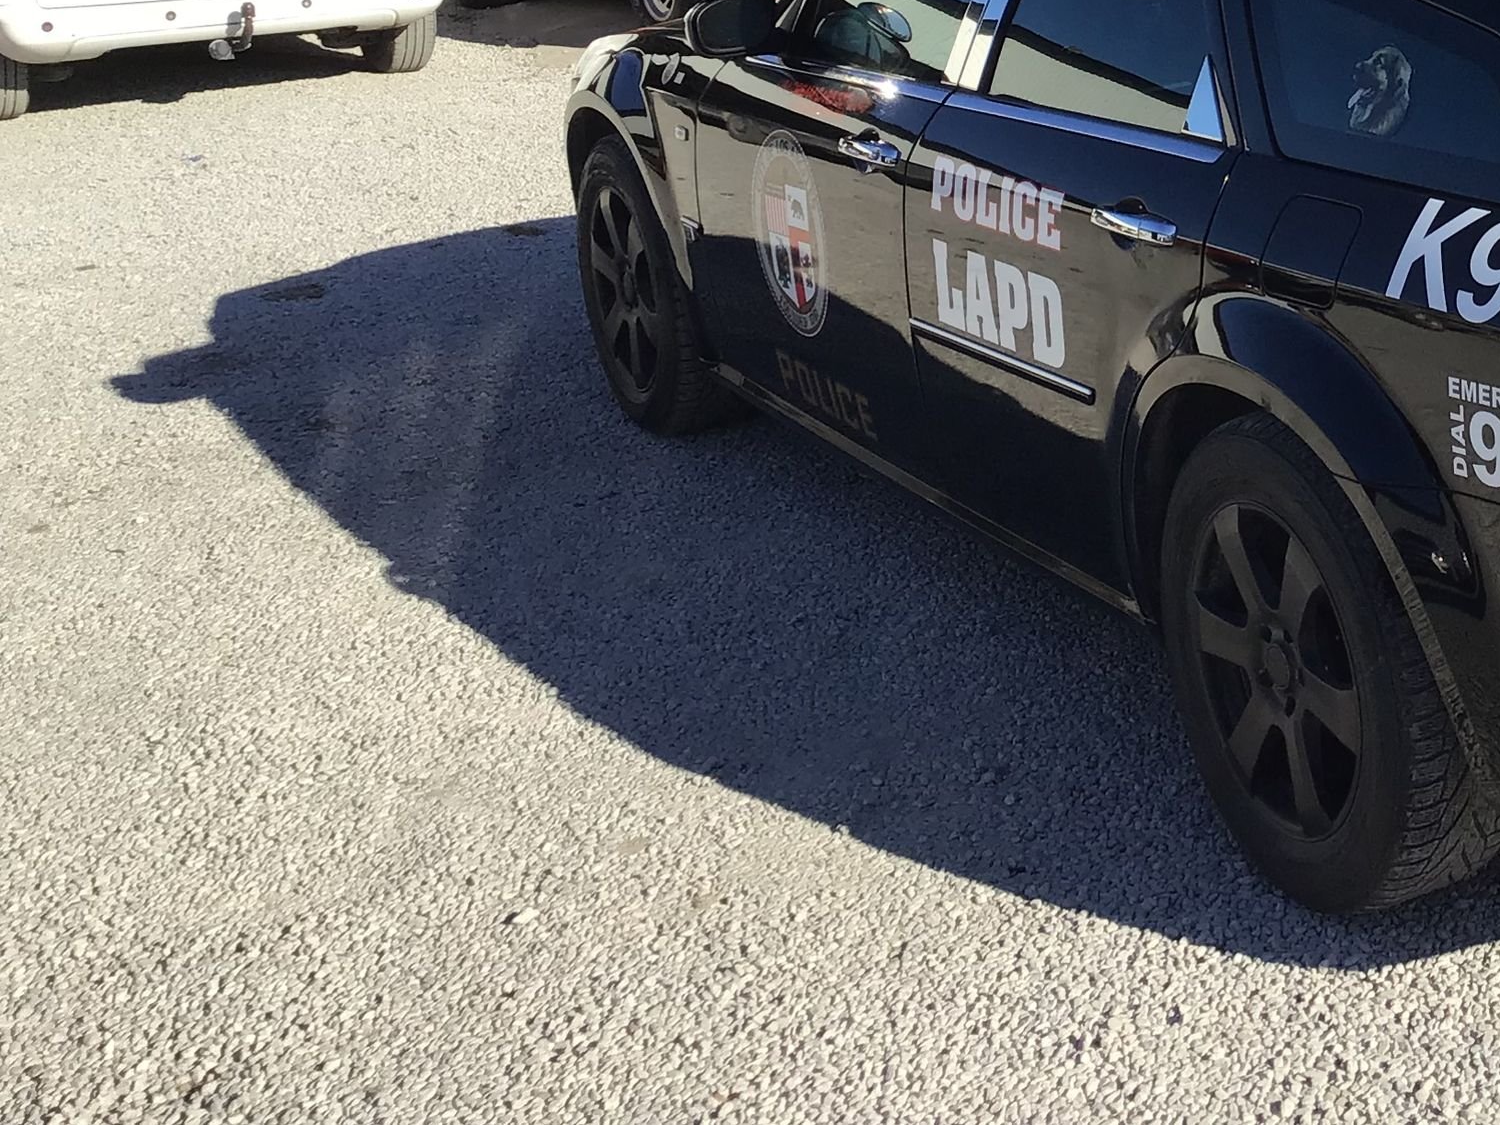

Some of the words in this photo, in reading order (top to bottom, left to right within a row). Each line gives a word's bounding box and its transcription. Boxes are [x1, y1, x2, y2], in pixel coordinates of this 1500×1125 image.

[931, 155, 1065, 251] POLICE
[932, 237, 1066, 369] LAPD
[775, 348, 878, 441] POLICE
[1449, 404, 1469, 479] DIAL
